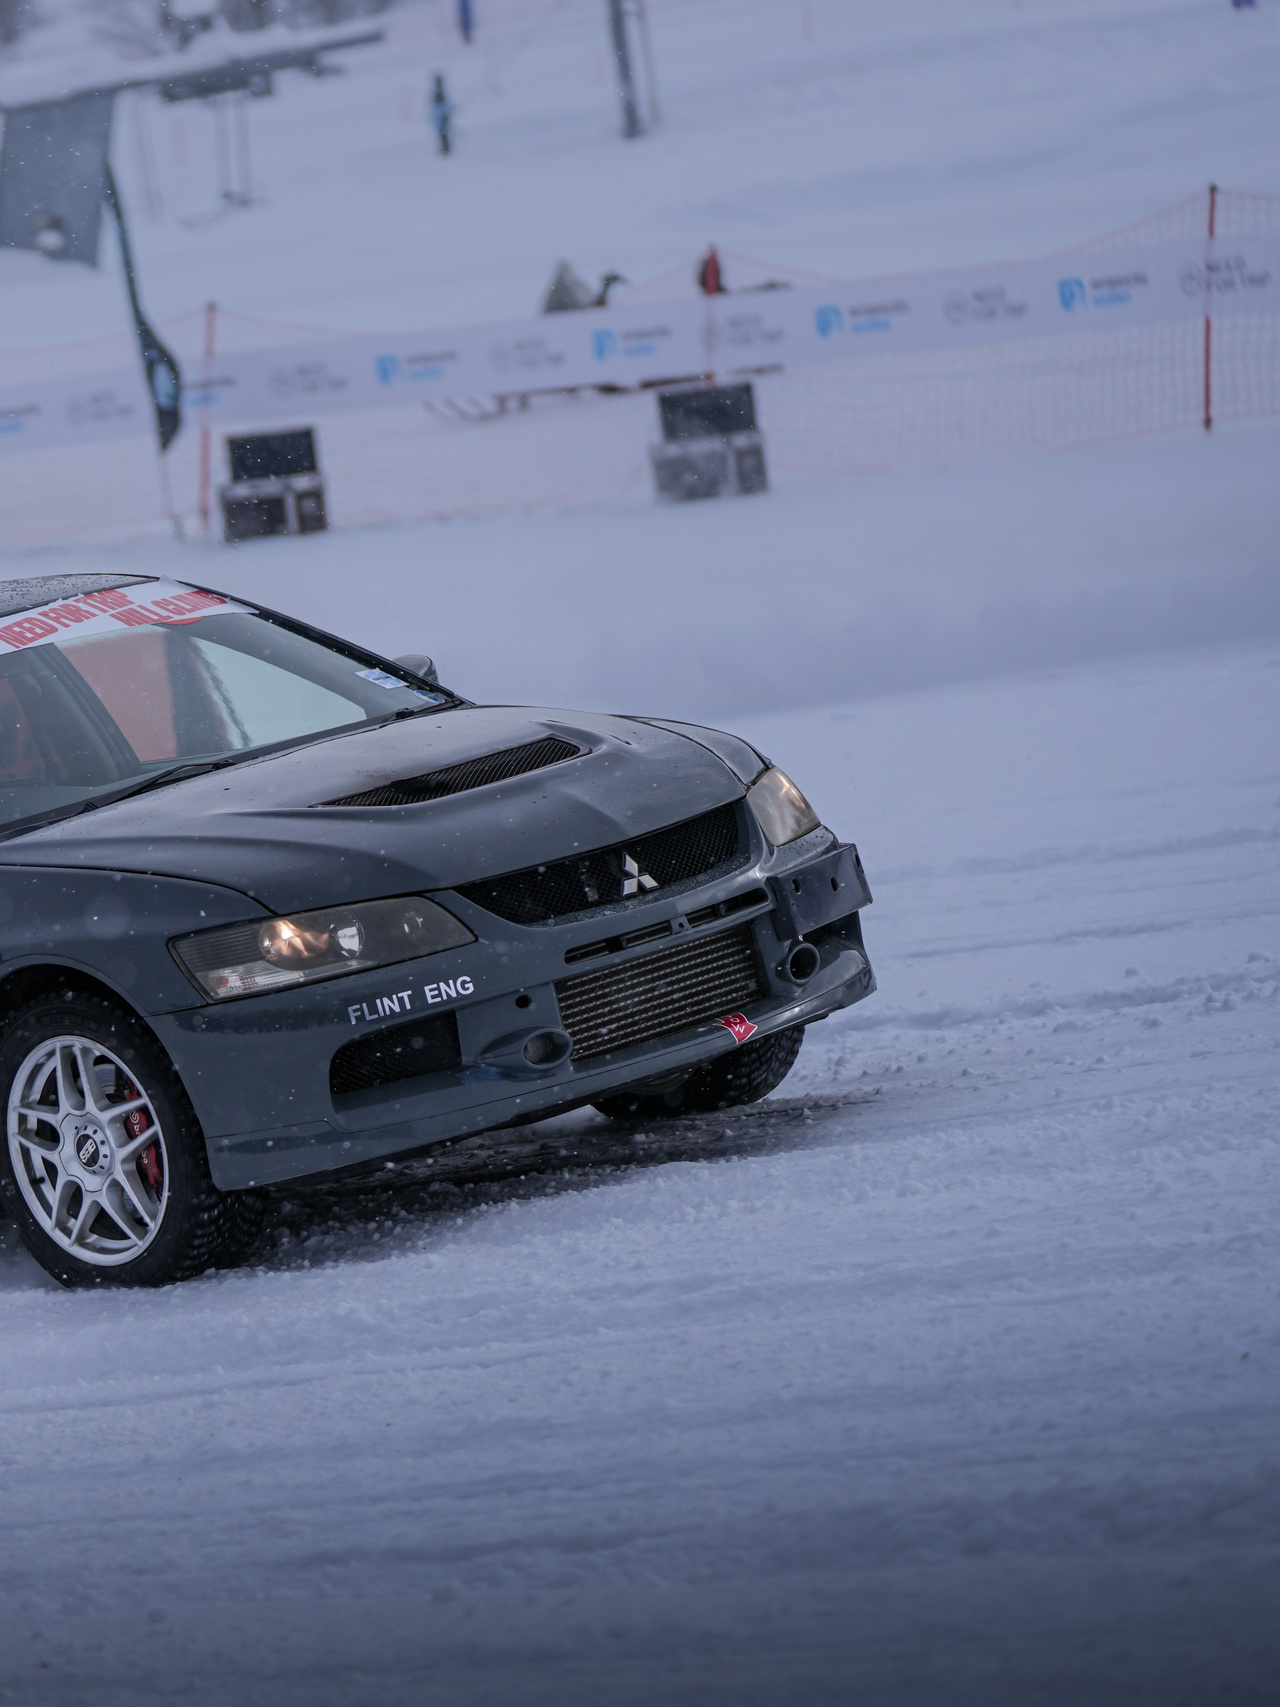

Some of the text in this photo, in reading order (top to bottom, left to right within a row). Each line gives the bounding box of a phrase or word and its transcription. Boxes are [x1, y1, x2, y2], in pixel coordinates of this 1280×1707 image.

[36, 602, 99, 629] FOR
[109, 604, 174, 627] HILL
[347, 975, 475, 1025] FLINT ENG
